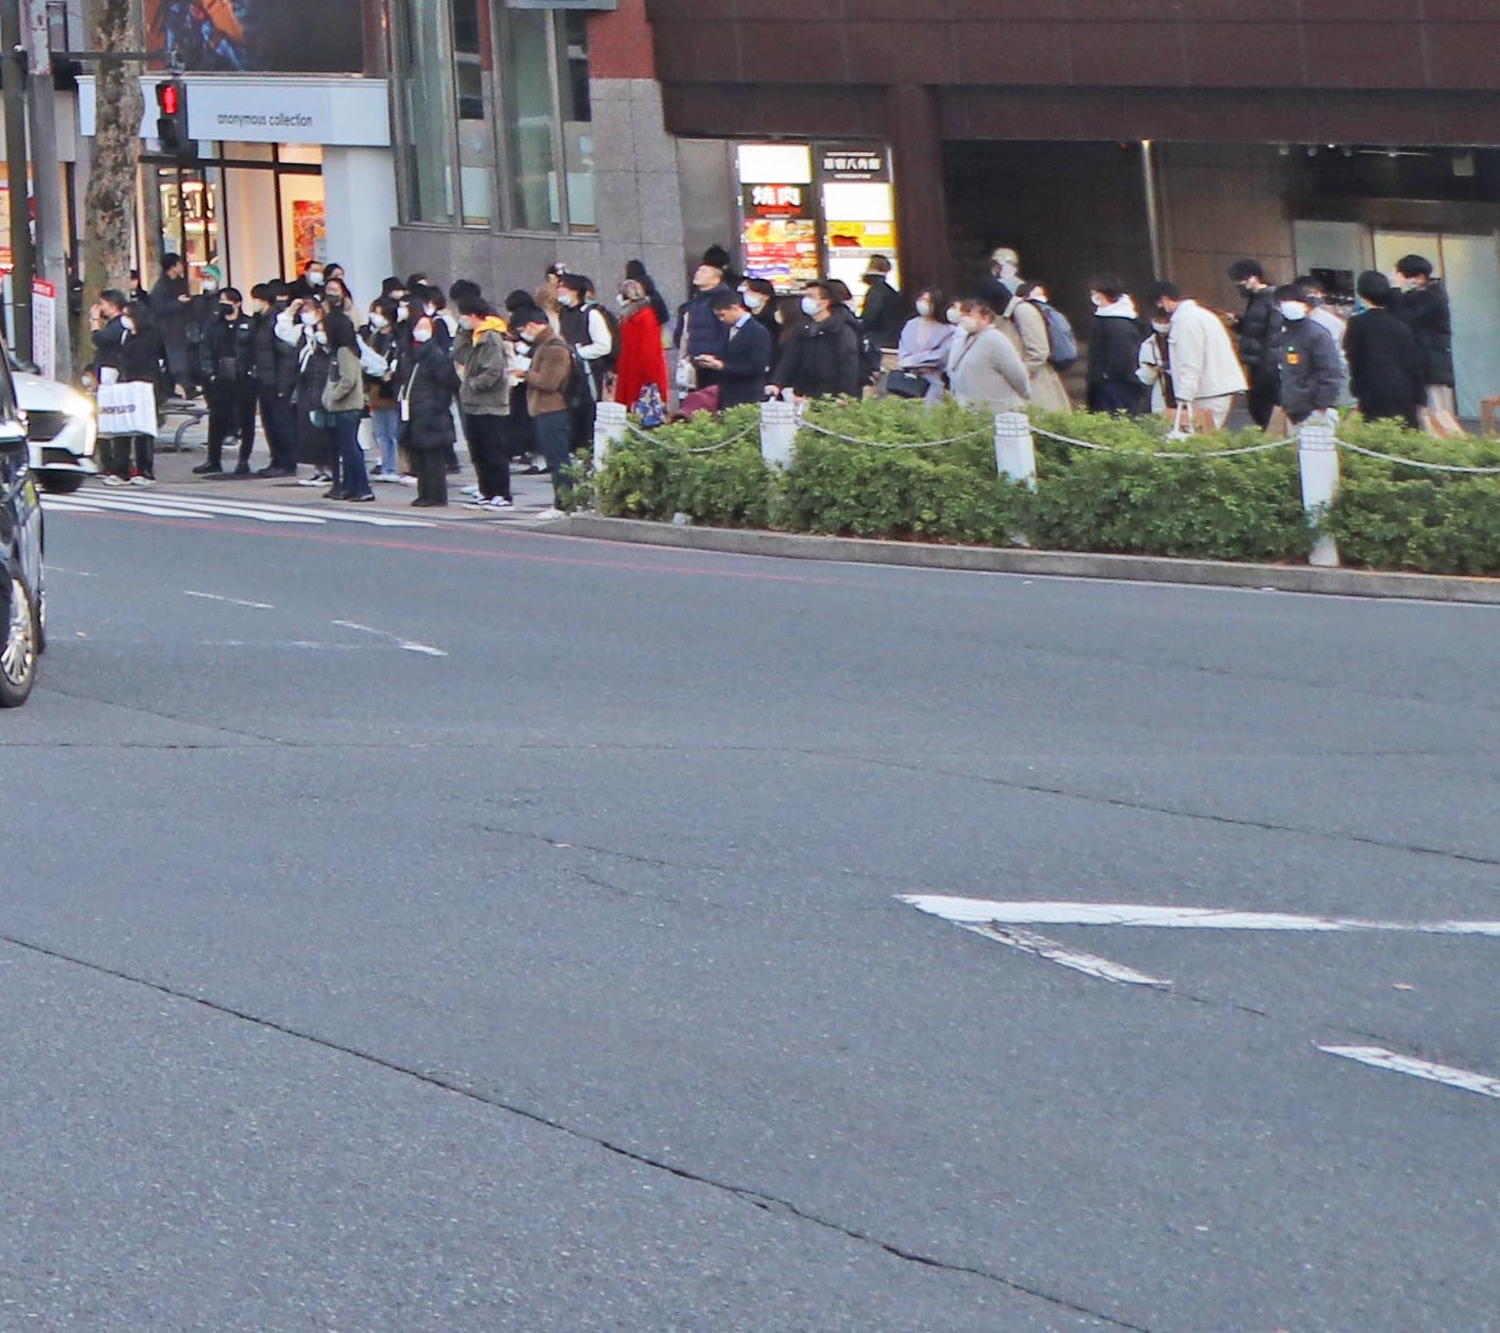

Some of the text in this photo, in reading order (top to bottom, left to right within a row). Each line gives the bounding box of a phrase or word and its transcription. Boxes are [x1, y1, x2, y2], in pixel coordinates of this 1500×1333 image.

[217, 113, 314, 128] anonymous collection
[751, 185, 801, 206] 焼肉
